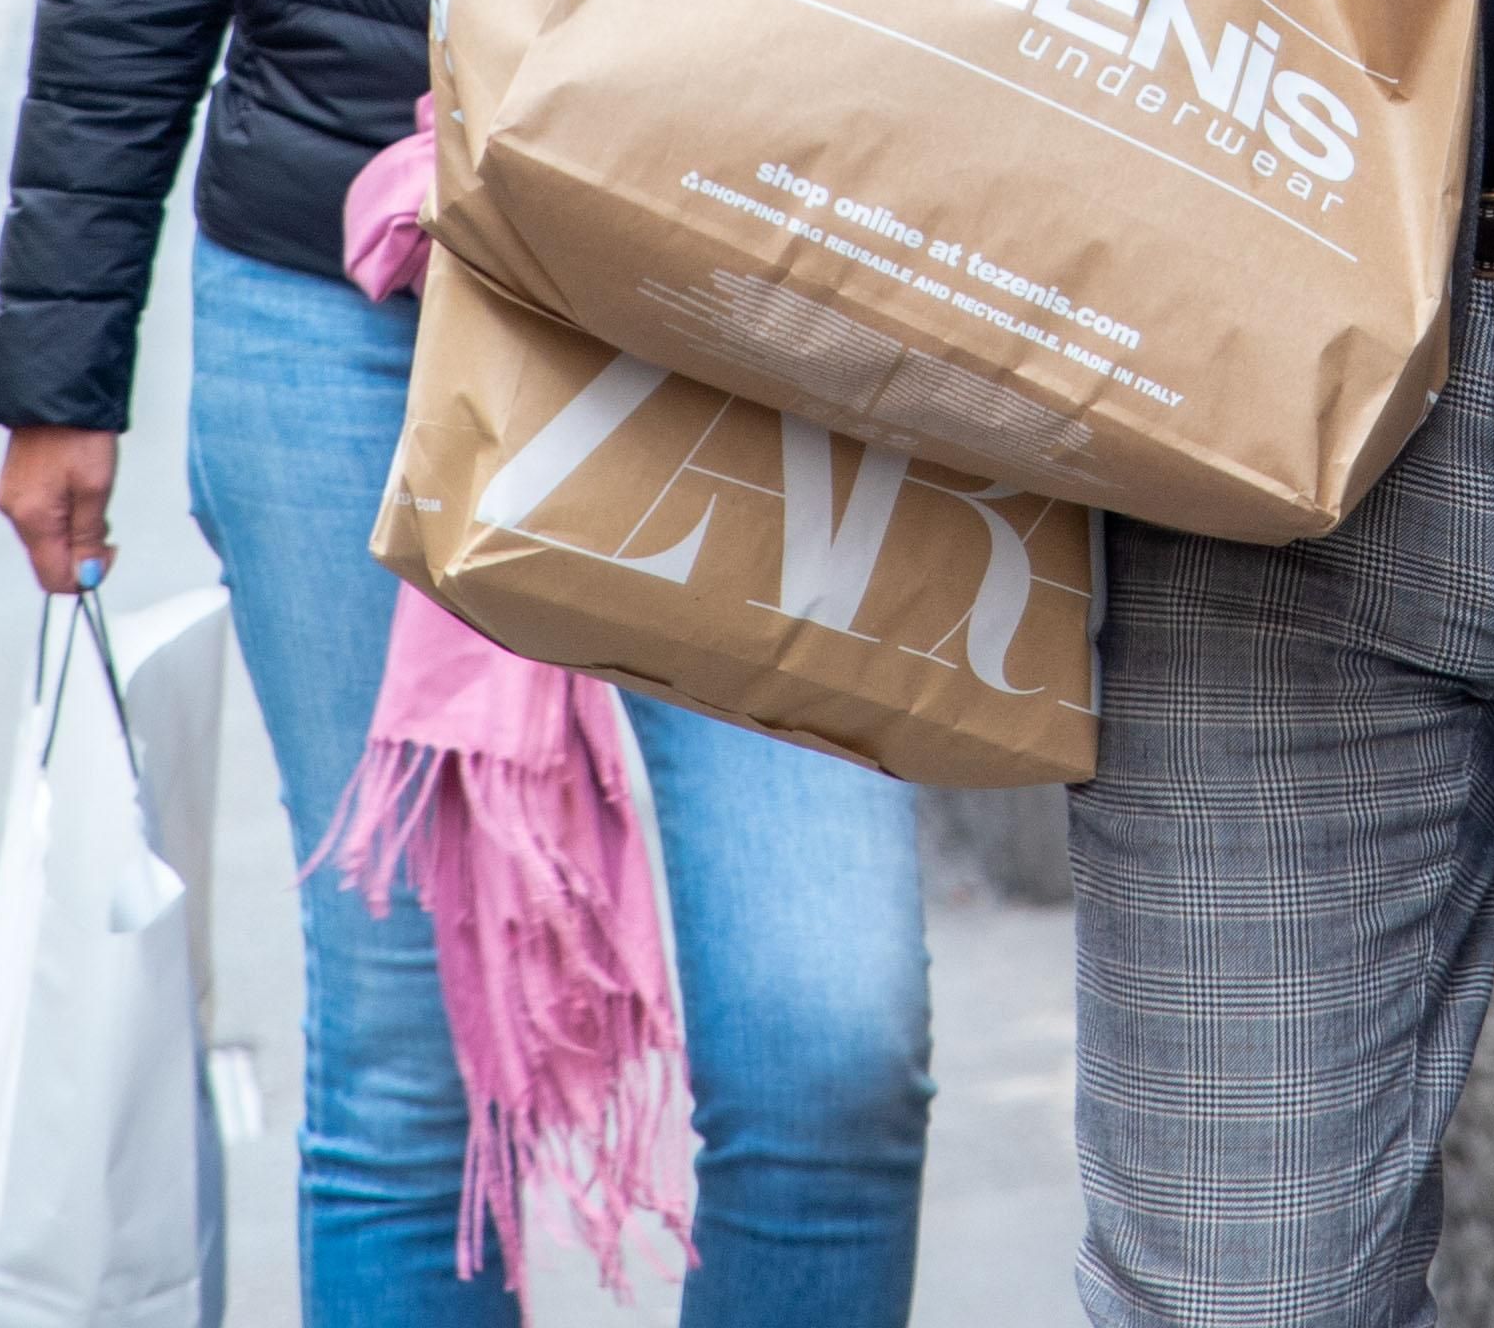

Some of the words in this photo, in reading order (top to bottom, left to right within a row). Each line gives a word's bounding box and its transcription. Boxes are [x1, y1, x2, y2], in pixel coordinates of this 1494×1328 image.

[1017, 25, 1345, 214] underwear
[699, 178, 786, 227] SHOPPING
[786, 216, 824, 243] BAG
[824, 233, 915, 284] REUSABLE
[913, 274, 951, 301] AND
[951, 290, 1062, 353] RECYCLABLE.
[1062, 341, 1114, 376] MADE
[1113, 365, 1135, 387] IN
[1134, 376, 1185, 408] ITALY
[756, 162, 830, 208] shop
[834, 197, 924, 249] online
[928, 239, 963, 268] at
[966, 252, 1141, 351] tezenis.com
